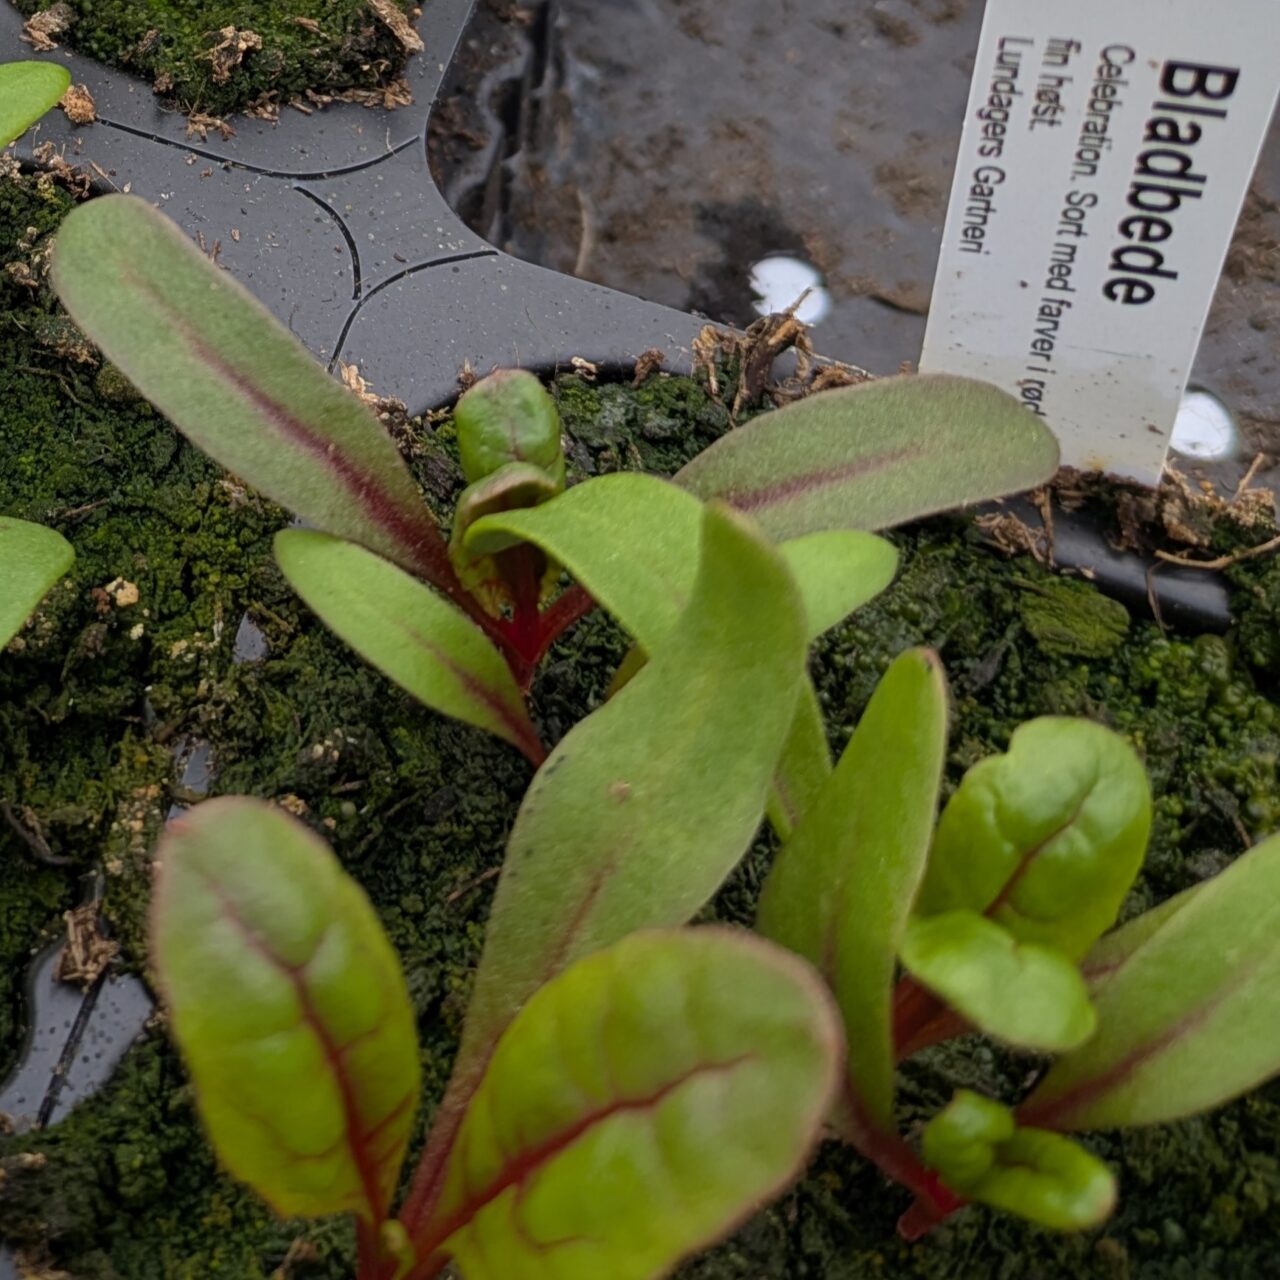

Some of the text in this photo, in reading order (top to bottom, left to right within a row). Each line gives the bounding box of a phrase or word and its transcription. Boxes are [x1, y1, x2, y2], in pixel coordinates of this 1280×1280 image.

[1028, 37, 1082, 132] fin høst.
[1069, 43, 1136, 182] Celebration.
[958, 36, 1034, 255] Lundagers Gartneri
[1102, 58, 1241, 306] Bladbede
[1056, 189, 1099, 237] Sort
[1045, 241, 1079, 293] med
[1029, 297, 1072, 362] farver
[1026, 365, 1057, 375] i
